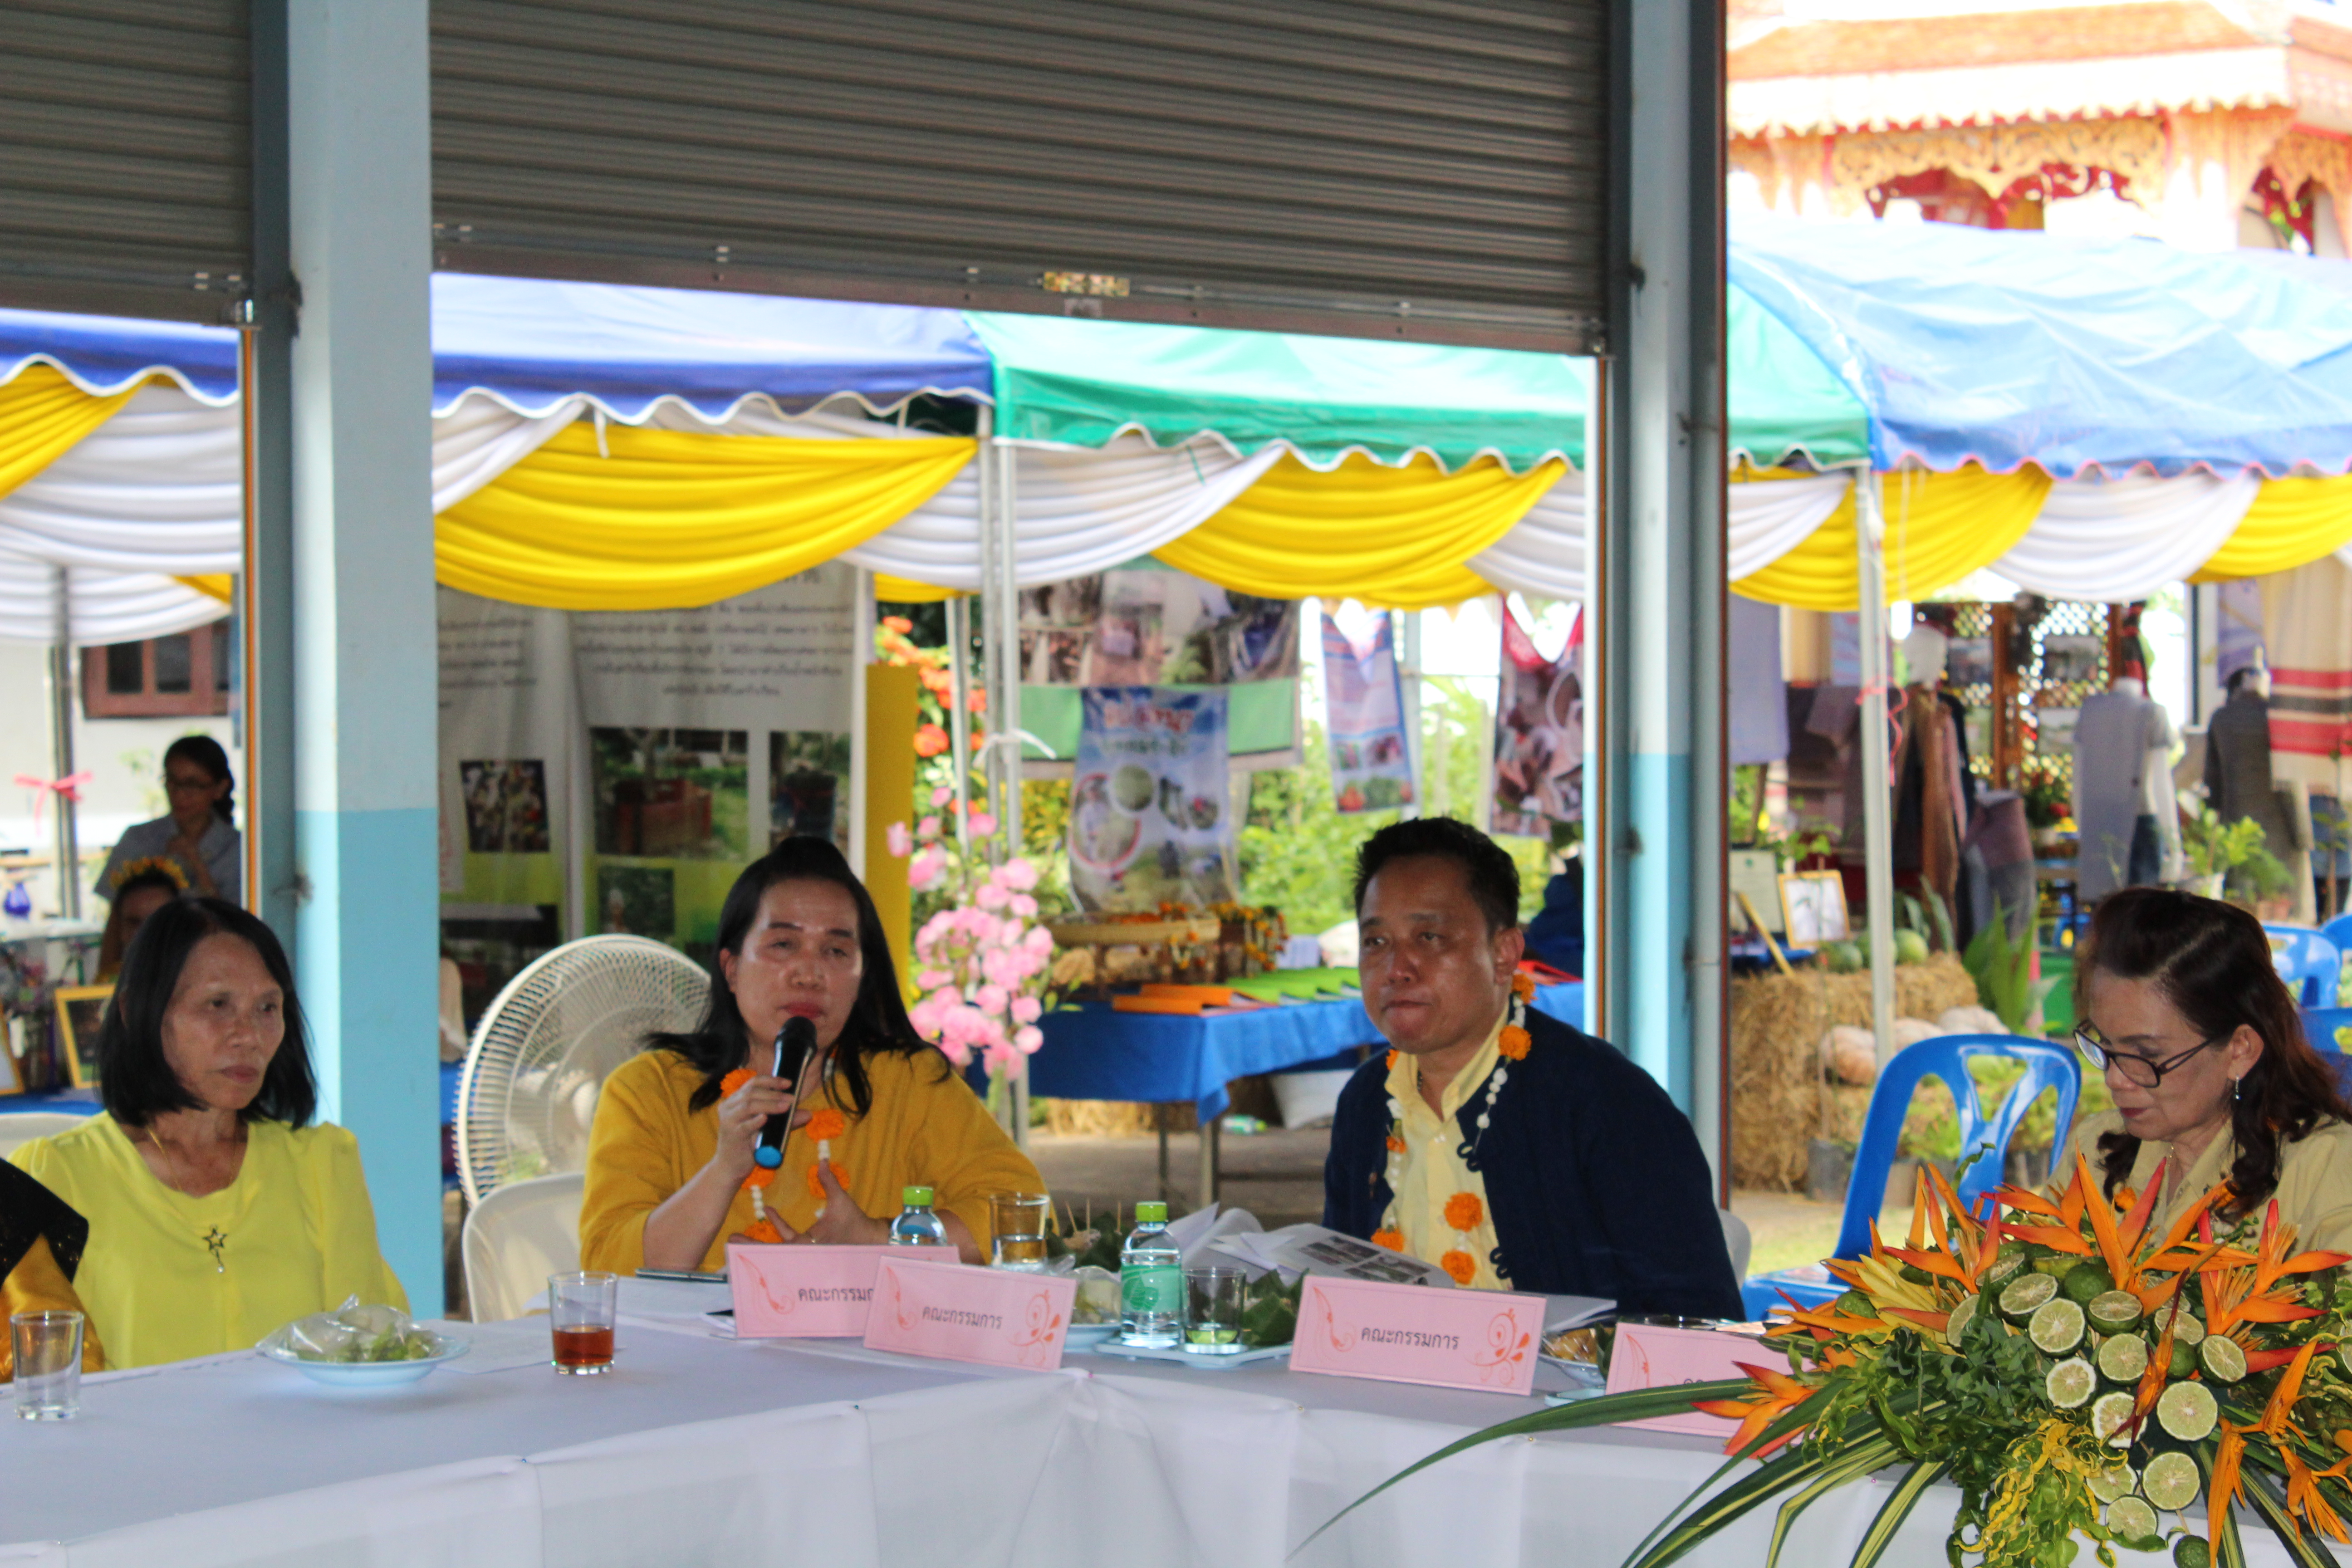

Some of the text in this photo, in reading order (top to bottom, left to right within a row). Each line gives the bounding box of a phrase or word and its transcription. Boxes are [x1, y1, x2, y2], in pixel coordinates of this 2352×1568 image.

[922, 1307, 1003, 1330] คณะกรรมการ
[1362, 1327, 1460, 1350] คณะกรรมการ
